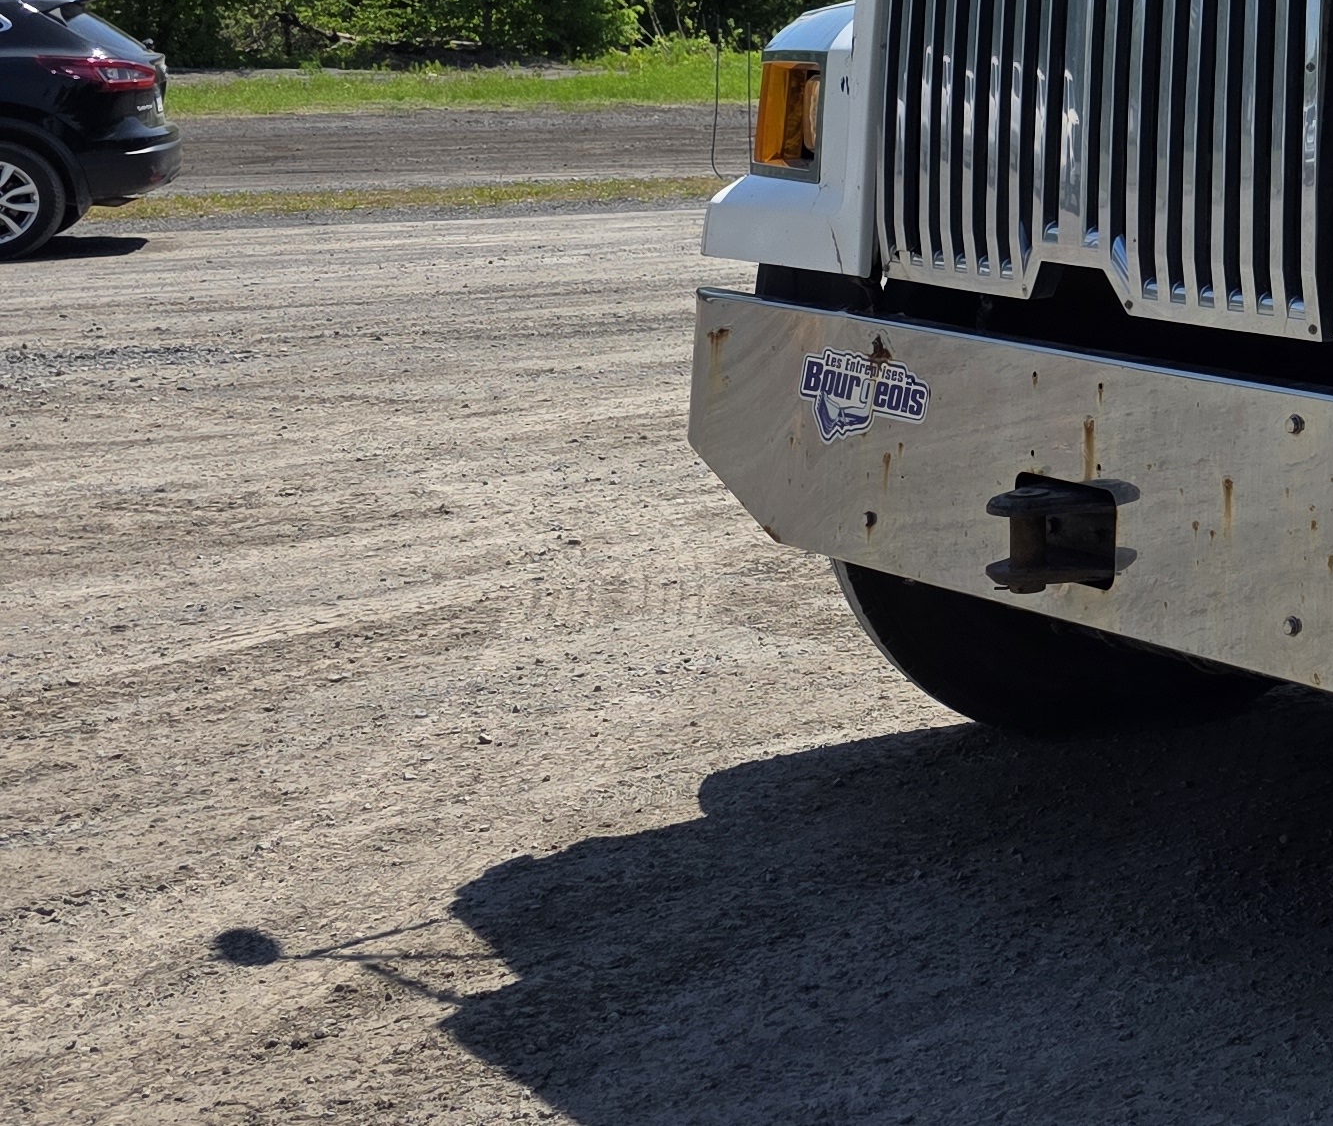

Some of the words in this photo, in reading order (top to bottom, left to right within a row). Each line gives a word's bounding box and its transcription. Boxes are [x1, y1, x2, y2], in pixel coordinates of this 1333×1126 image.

[802, 359, 926, 419] Bourgeois
[825, 353, 843, 370] Les
[844, 357, 904, 383] Entreprises
